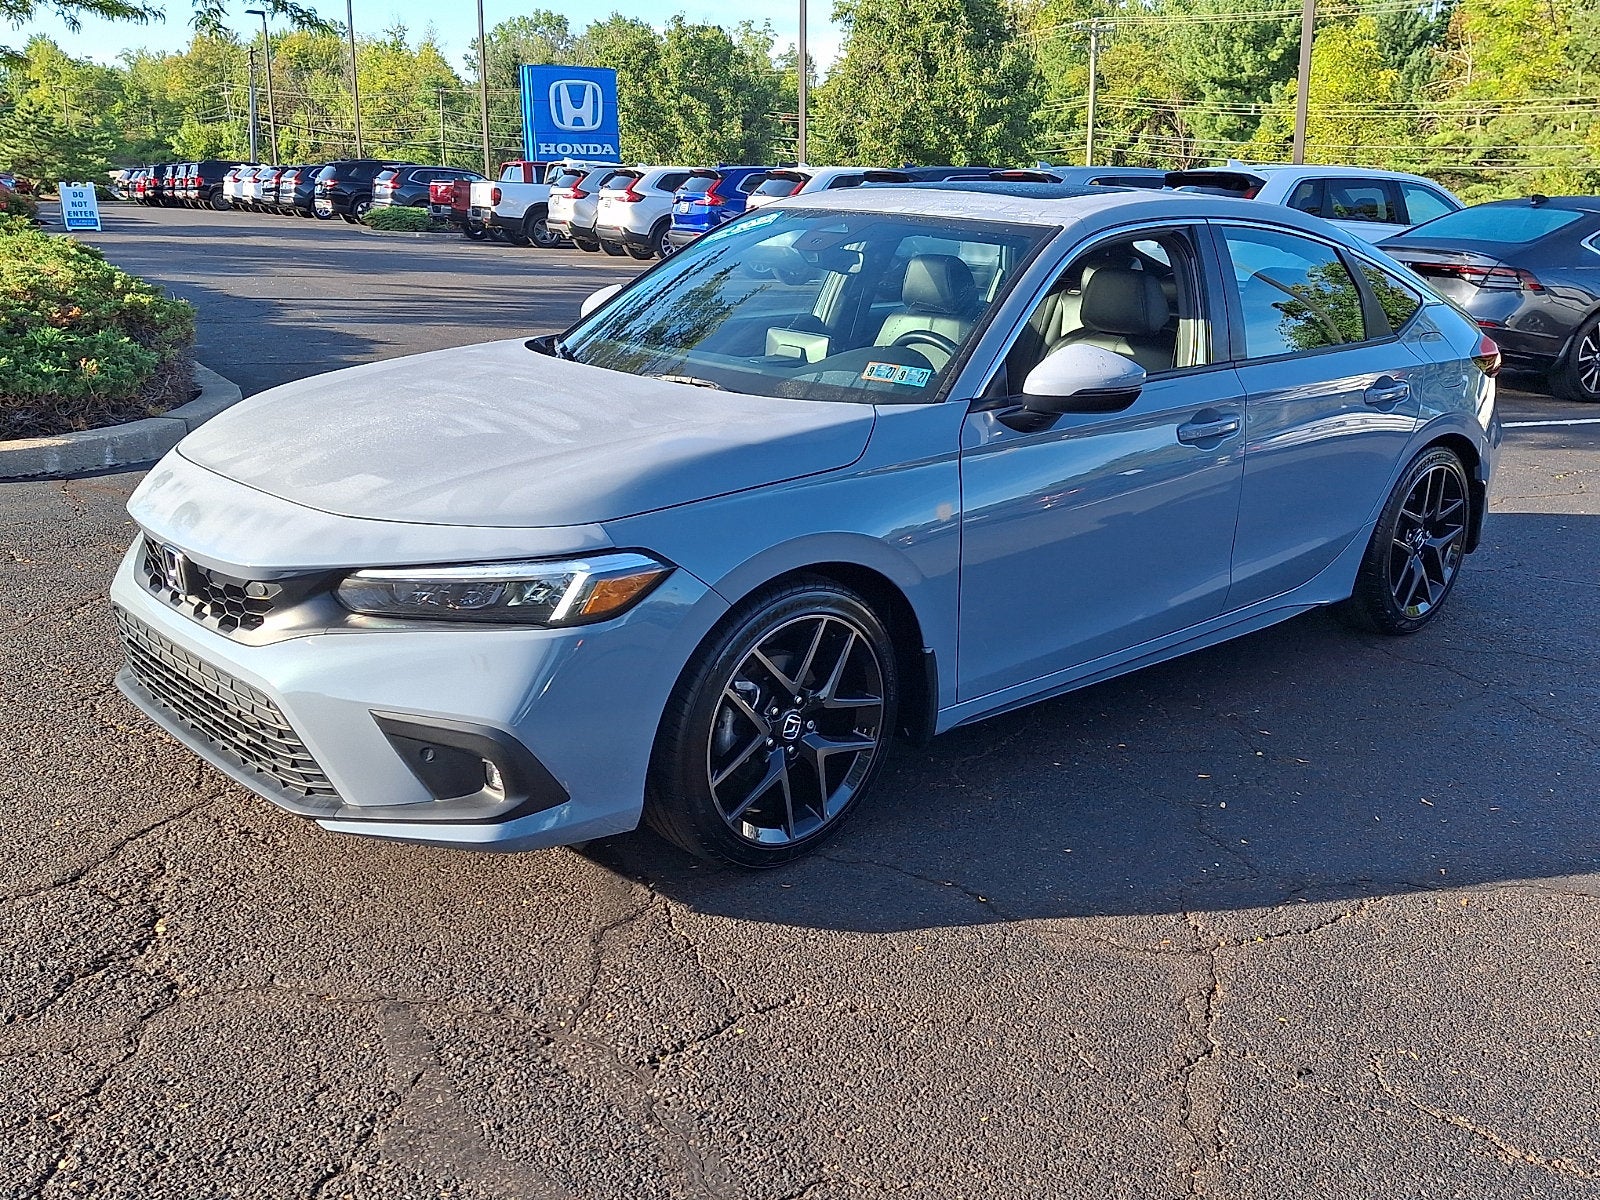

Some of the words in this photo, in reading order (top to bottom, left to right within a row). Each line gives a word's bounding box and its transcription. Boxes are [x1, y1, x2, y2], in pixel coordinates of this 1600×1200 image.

[538, 143, 616, 155] HONDA
[885, 367, 896, 379] 27
[917, 371, 928, 383] 27
